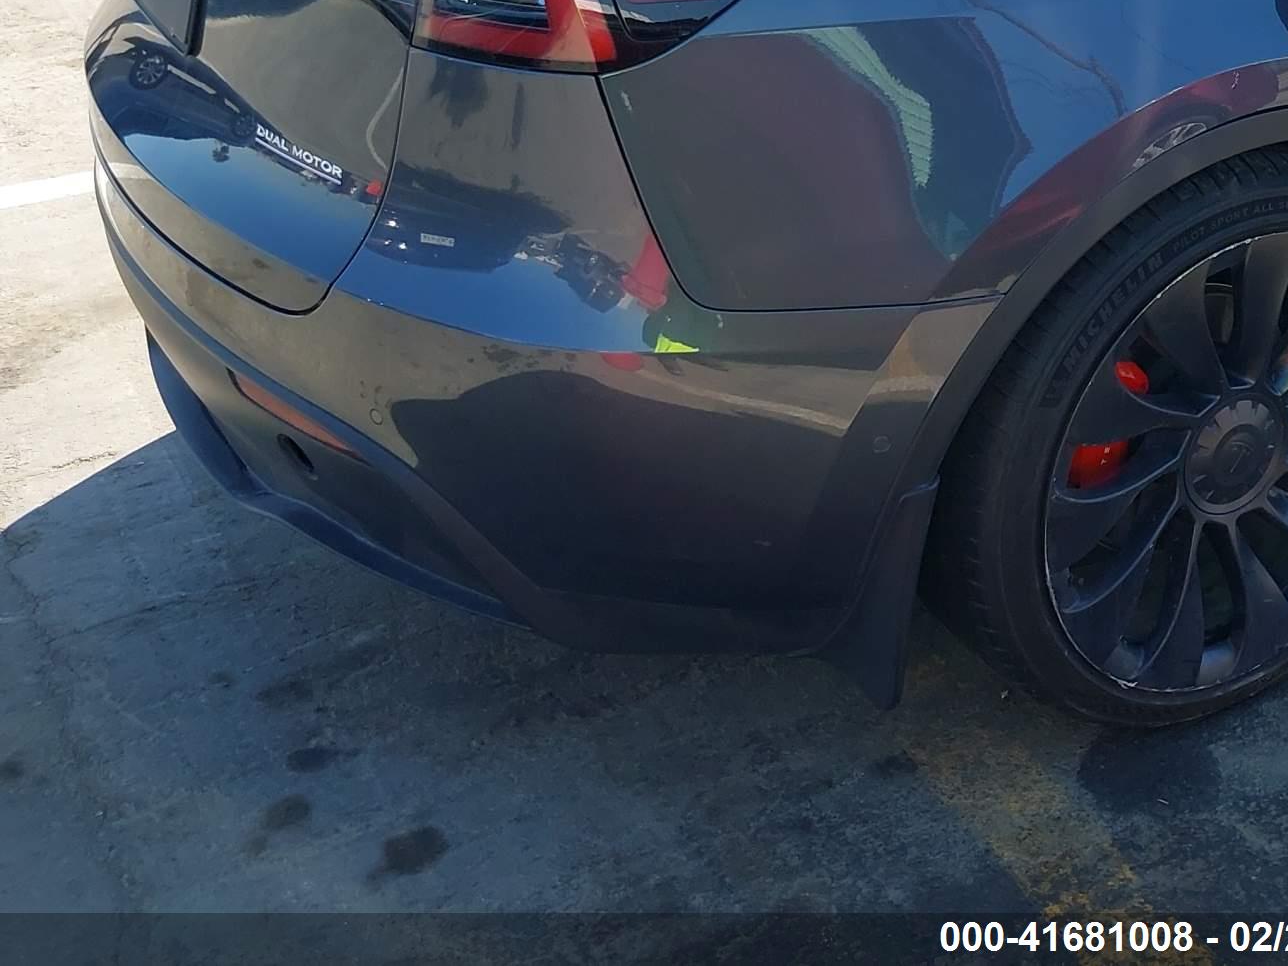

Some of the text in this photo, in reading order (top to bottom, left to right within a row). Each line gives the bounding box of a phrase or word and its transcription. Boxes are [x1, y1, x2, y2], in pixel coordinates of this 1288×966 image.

[256, 123, 343, 179] DUAL MOTOR
[1062, 250, 1165, 374] MICHELIN
[1173, 225, 1206, 255] PILOT
[1211, 206, 1249, 233] SPORT
[1251, 201, 1275, 215] ALL
